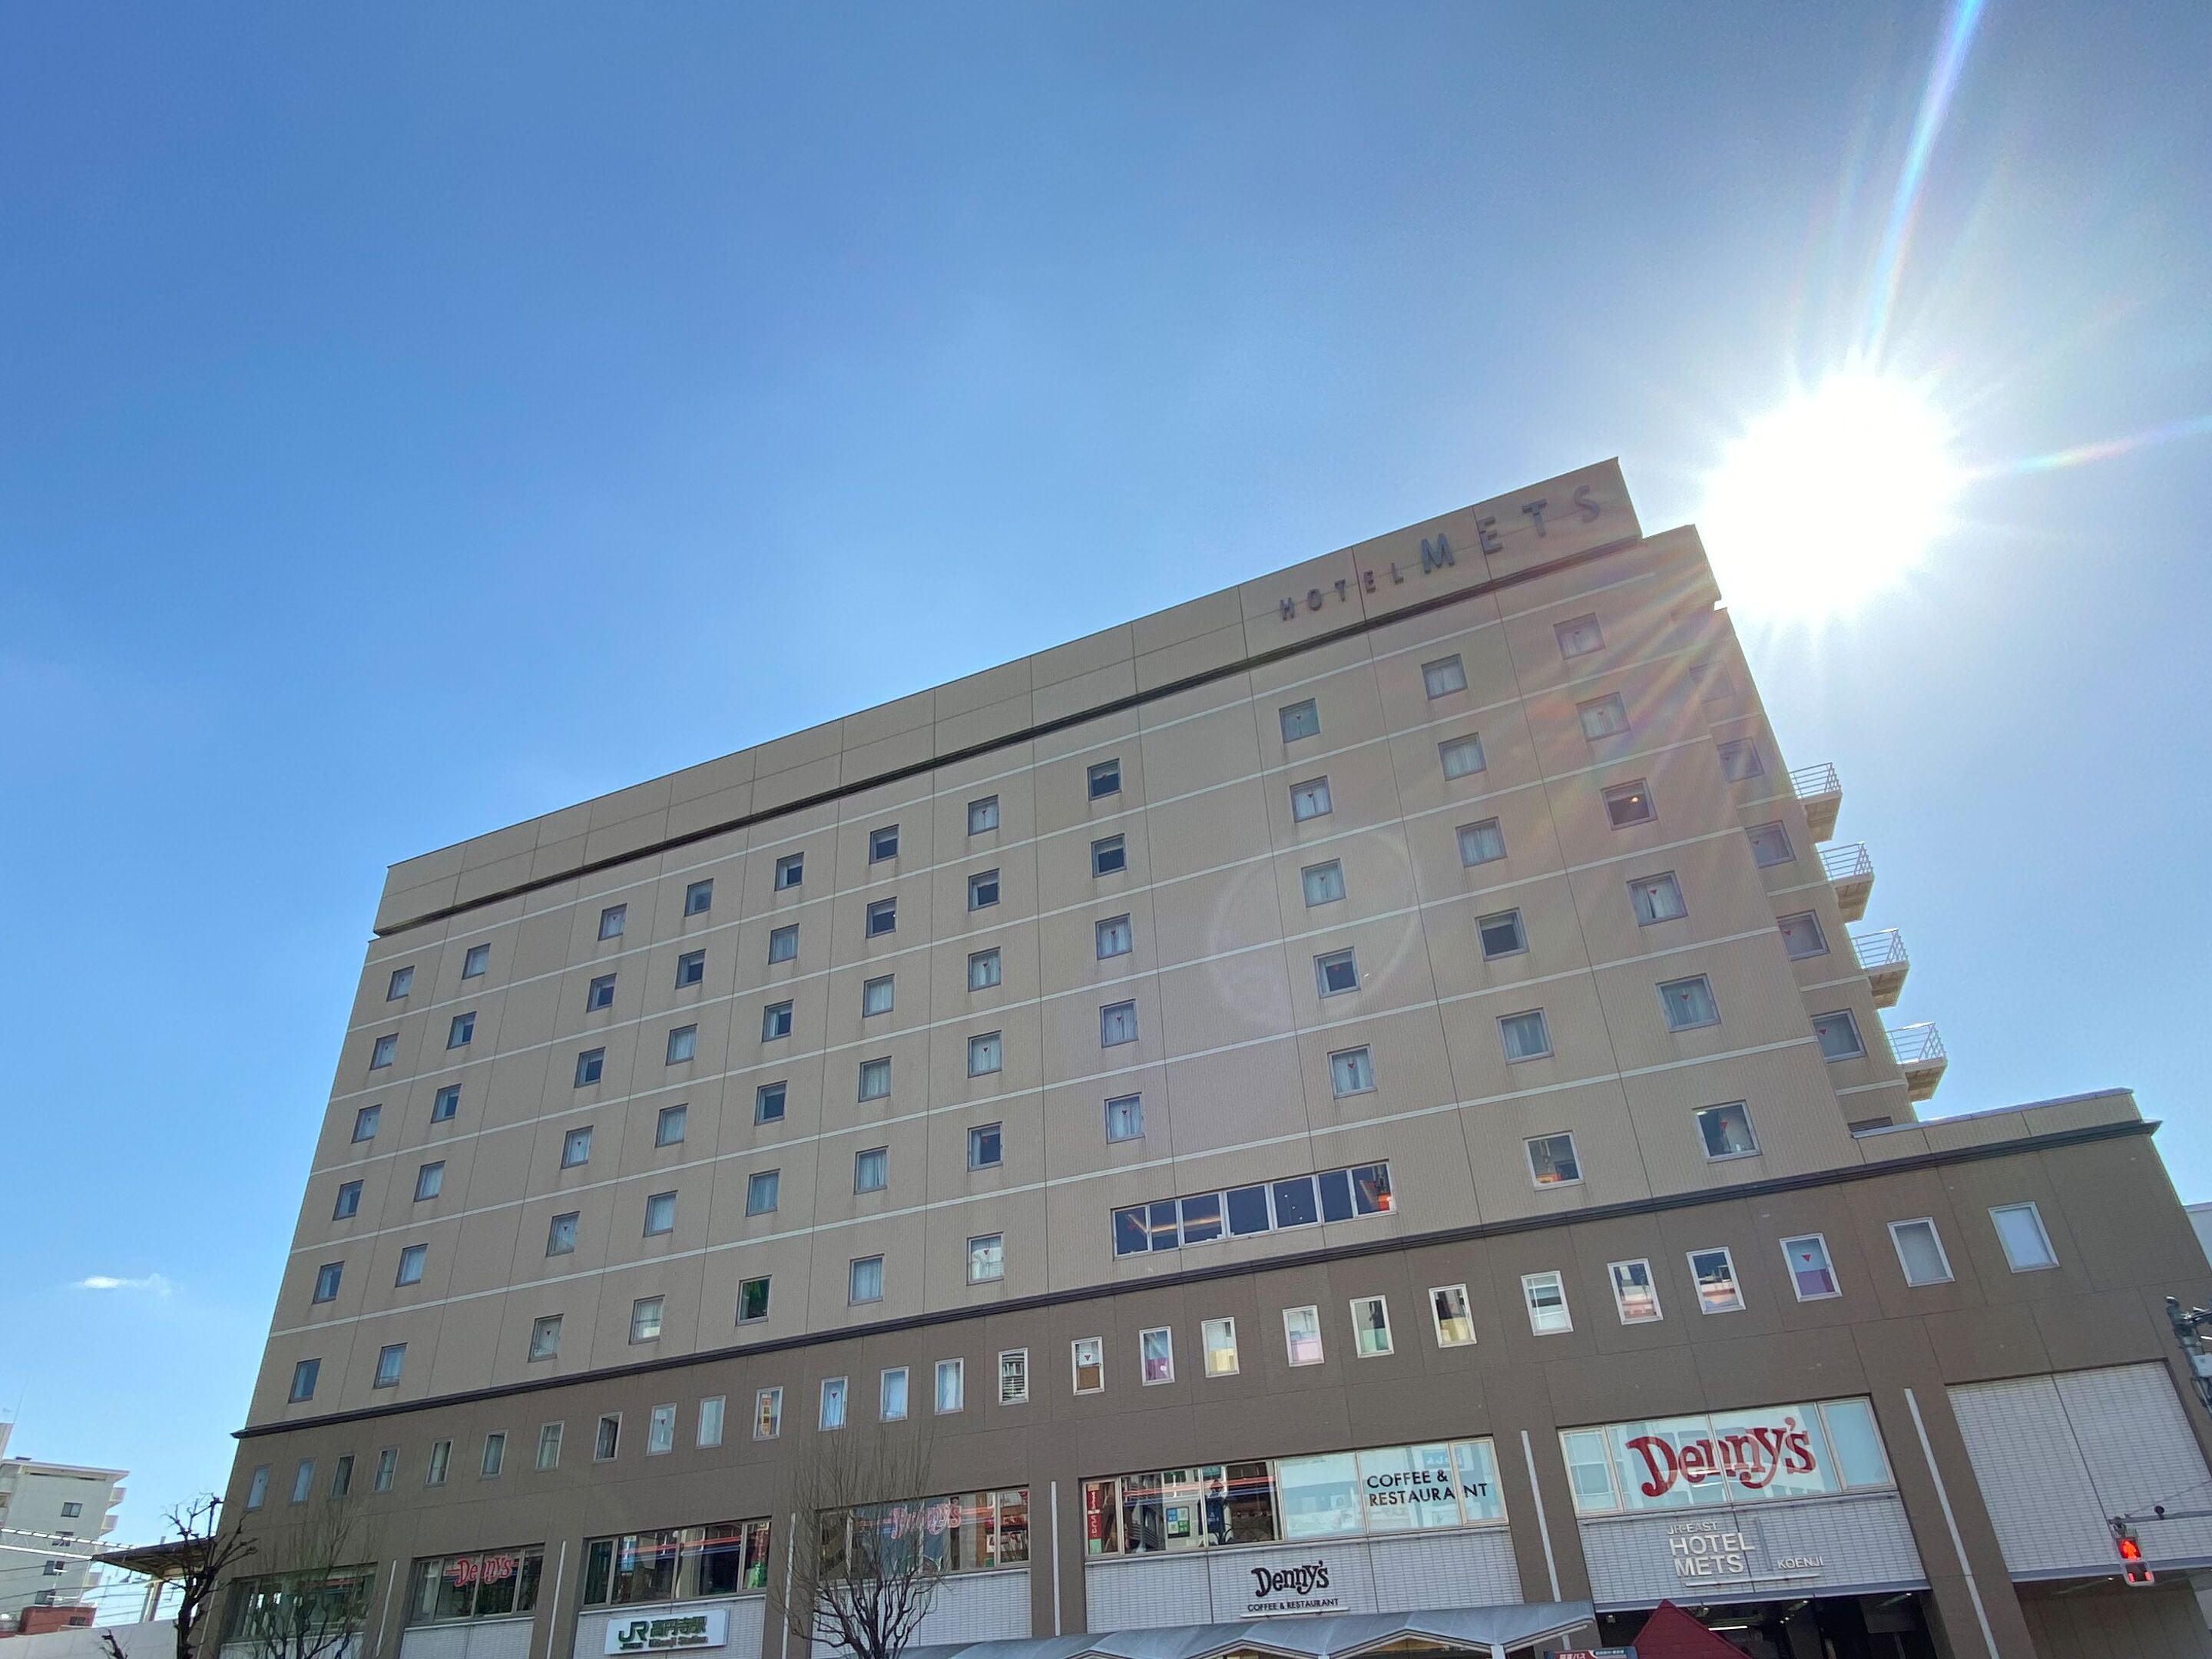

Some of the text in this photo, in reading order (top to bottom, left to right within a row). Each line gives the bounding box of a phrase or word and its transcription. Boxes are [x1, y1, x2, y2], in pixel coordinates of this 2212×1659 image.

[1280, 485, 1601, 622] HOTEL METS
[1624, 1416, 1817, 1498] Denny's
[1366, 1469, 1449, 1488] COFFEE &
[1369, 1483, 1488, 1507] RESTAURANT
[1669, 1532, 1756, 1556] HOTEL
[1674, 1554, 1744, 1578] METS
[1777, 1555, 1823, 1570] KOENJI
[1250, 1560, 1330, 1598] Denny's
[1247, 1602, 1277, 1612] COFFEE
[1286, 1598, 1339, 1610] RESTAURANT
[618, 1621, 650, 1642] JR
